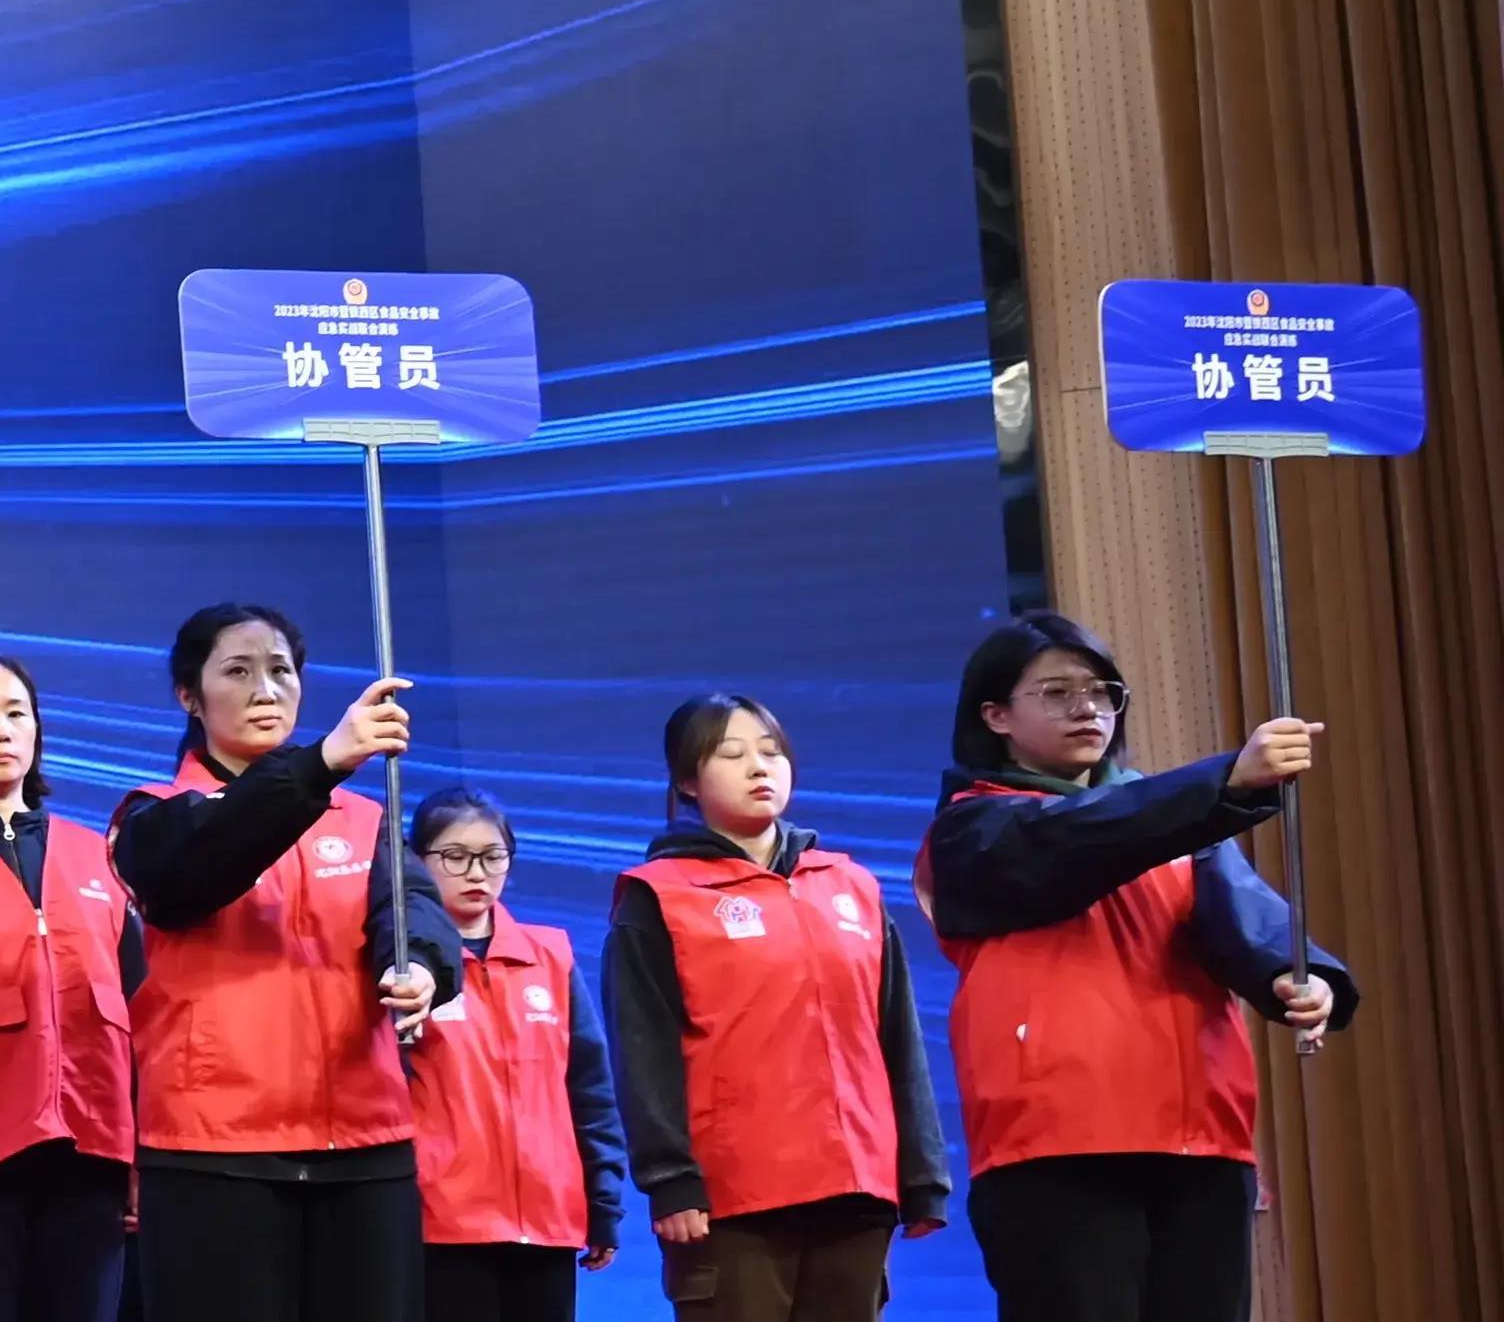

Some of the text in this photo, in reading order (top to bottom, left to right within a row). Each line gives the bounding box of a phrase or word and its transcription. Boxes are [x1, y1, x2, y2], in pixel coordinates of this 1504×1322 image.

[281, 340, 441, 390] 协管员
[1191, 352, 1336, 402] 协管员
